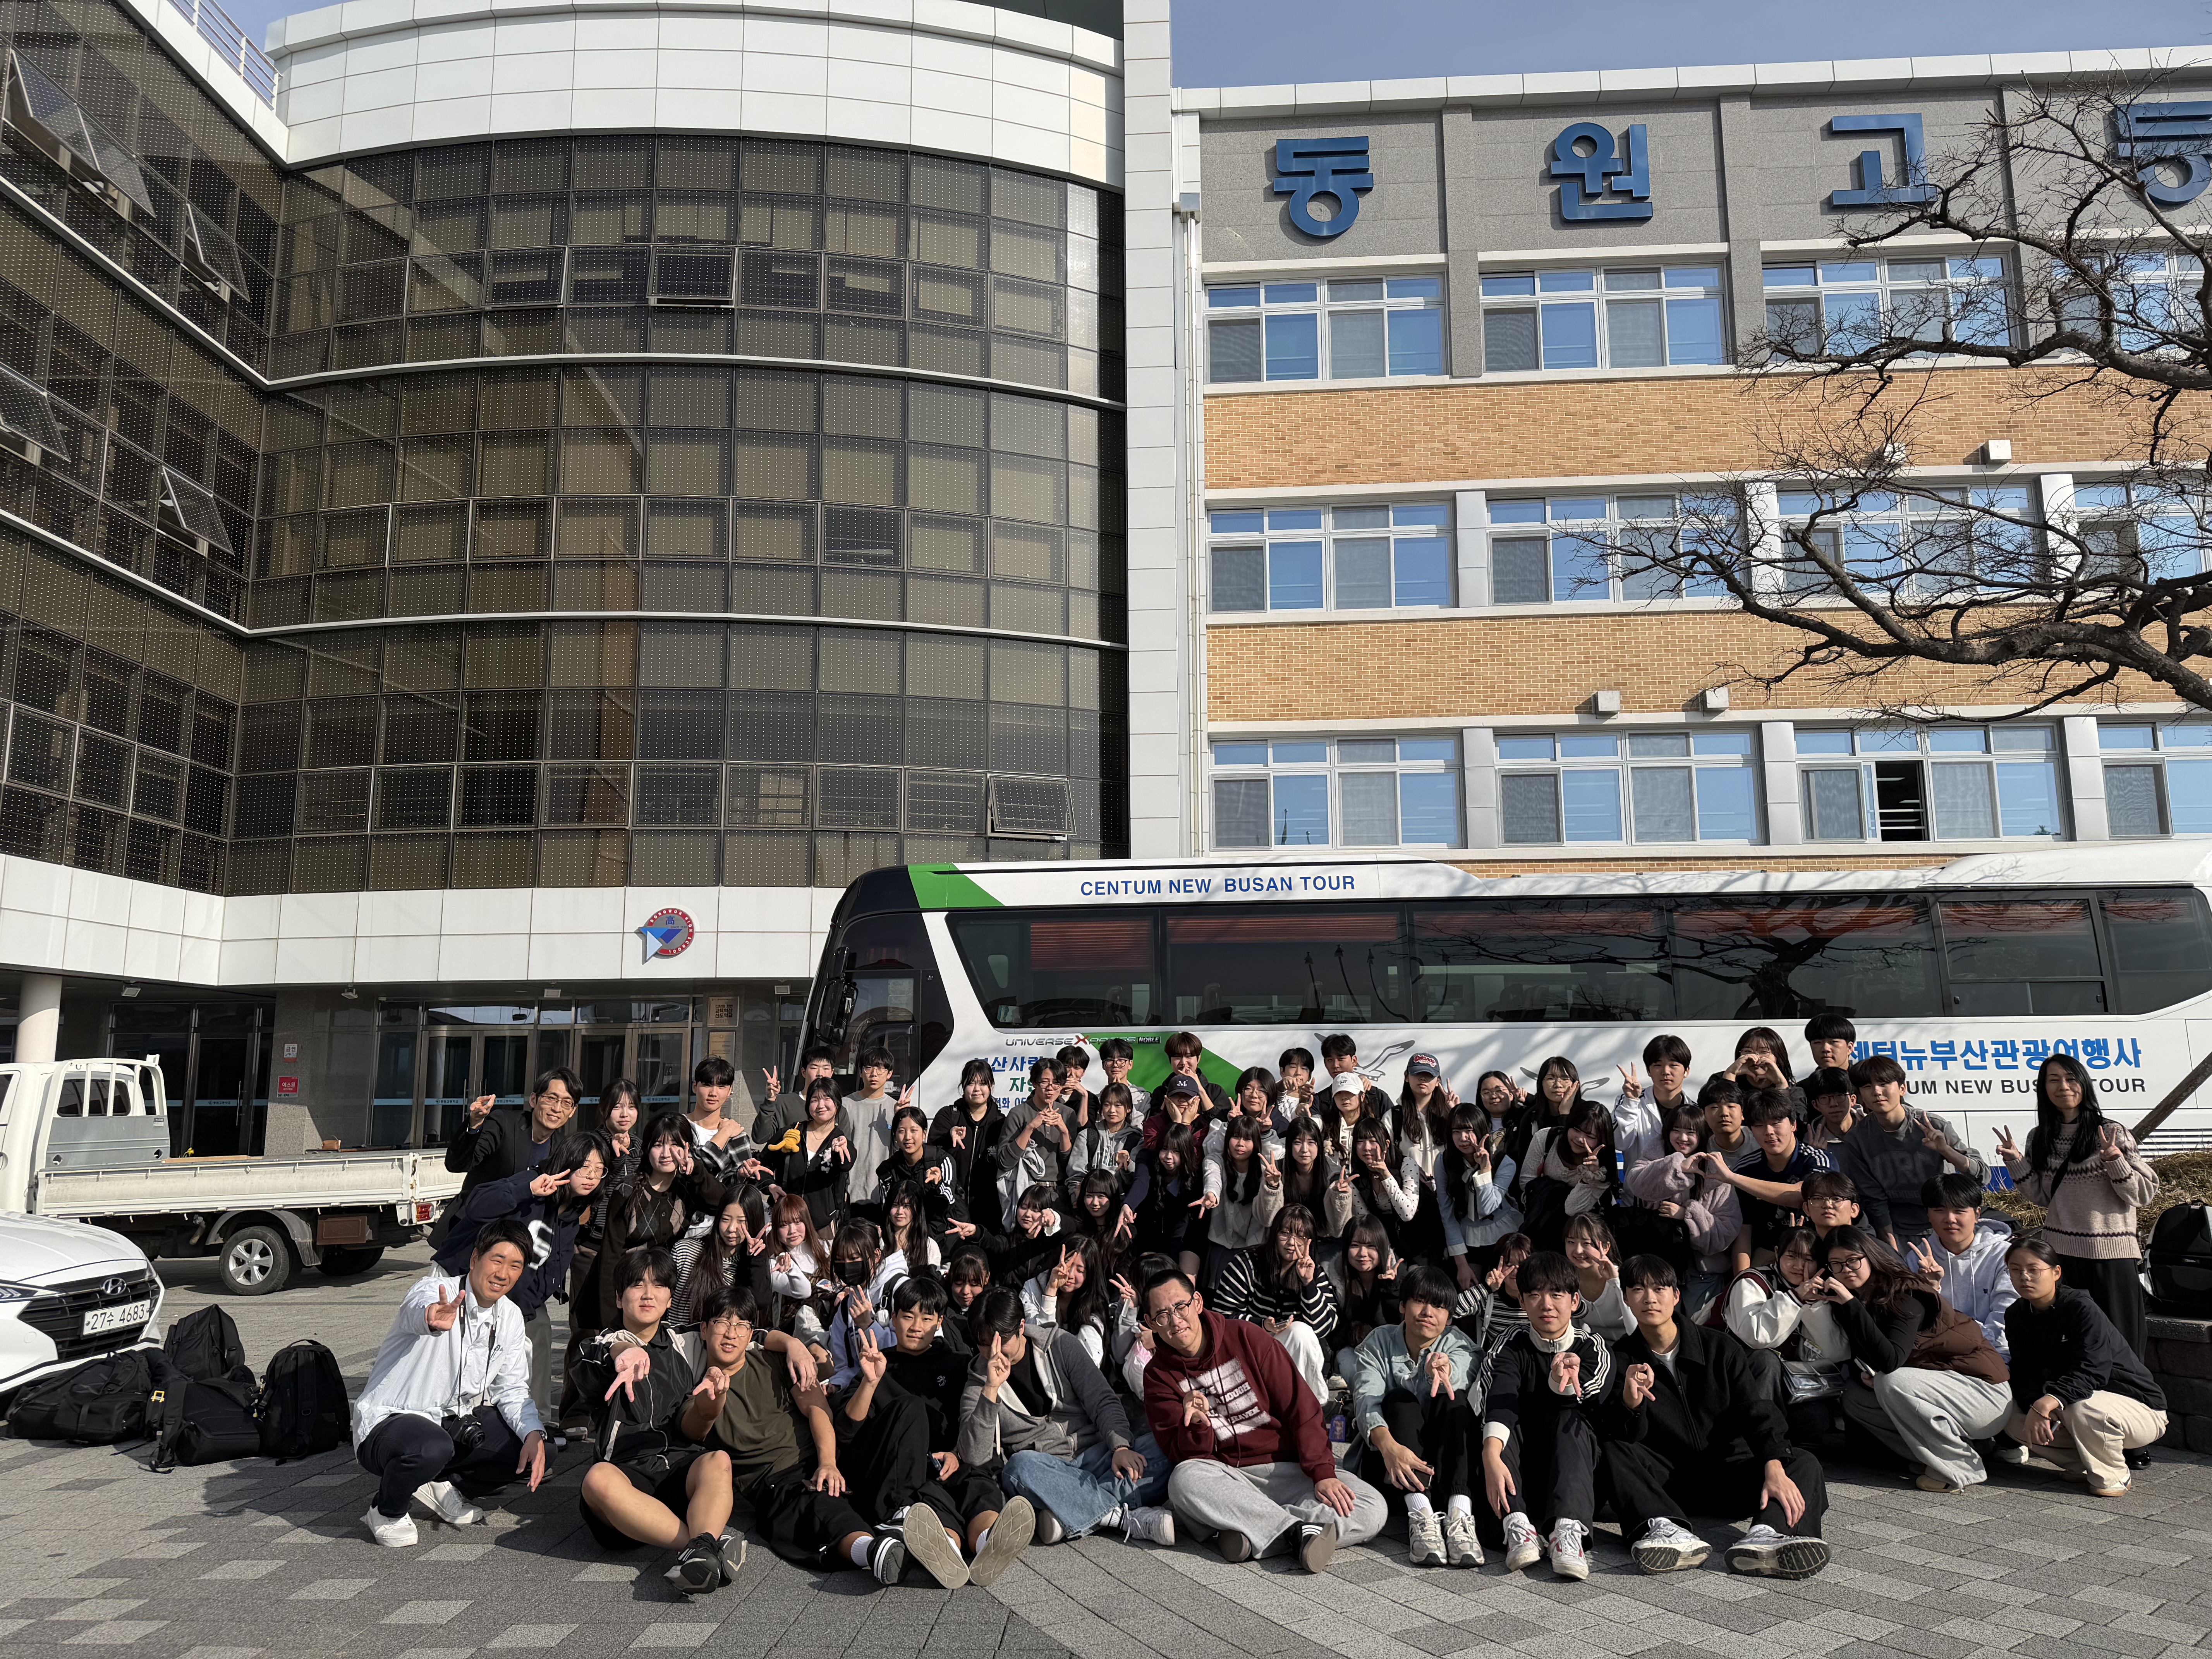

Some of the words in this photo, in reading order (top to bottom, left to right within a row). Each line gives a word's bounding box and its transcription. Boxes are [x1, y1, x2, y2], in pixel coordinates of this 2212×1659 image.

[1081, 881, 1161, 896] CENTUM
[1170, 880, 1211, 893] NEW
[1225, 878, 1292, 892] BUSAN
[1301, 876, 1354, 890] TOUR
[1946, 1080, 1992, 1093] NEW
[91, 1312, 114, 1330] 27수
[119, 1304, 145, 1323] 4683
